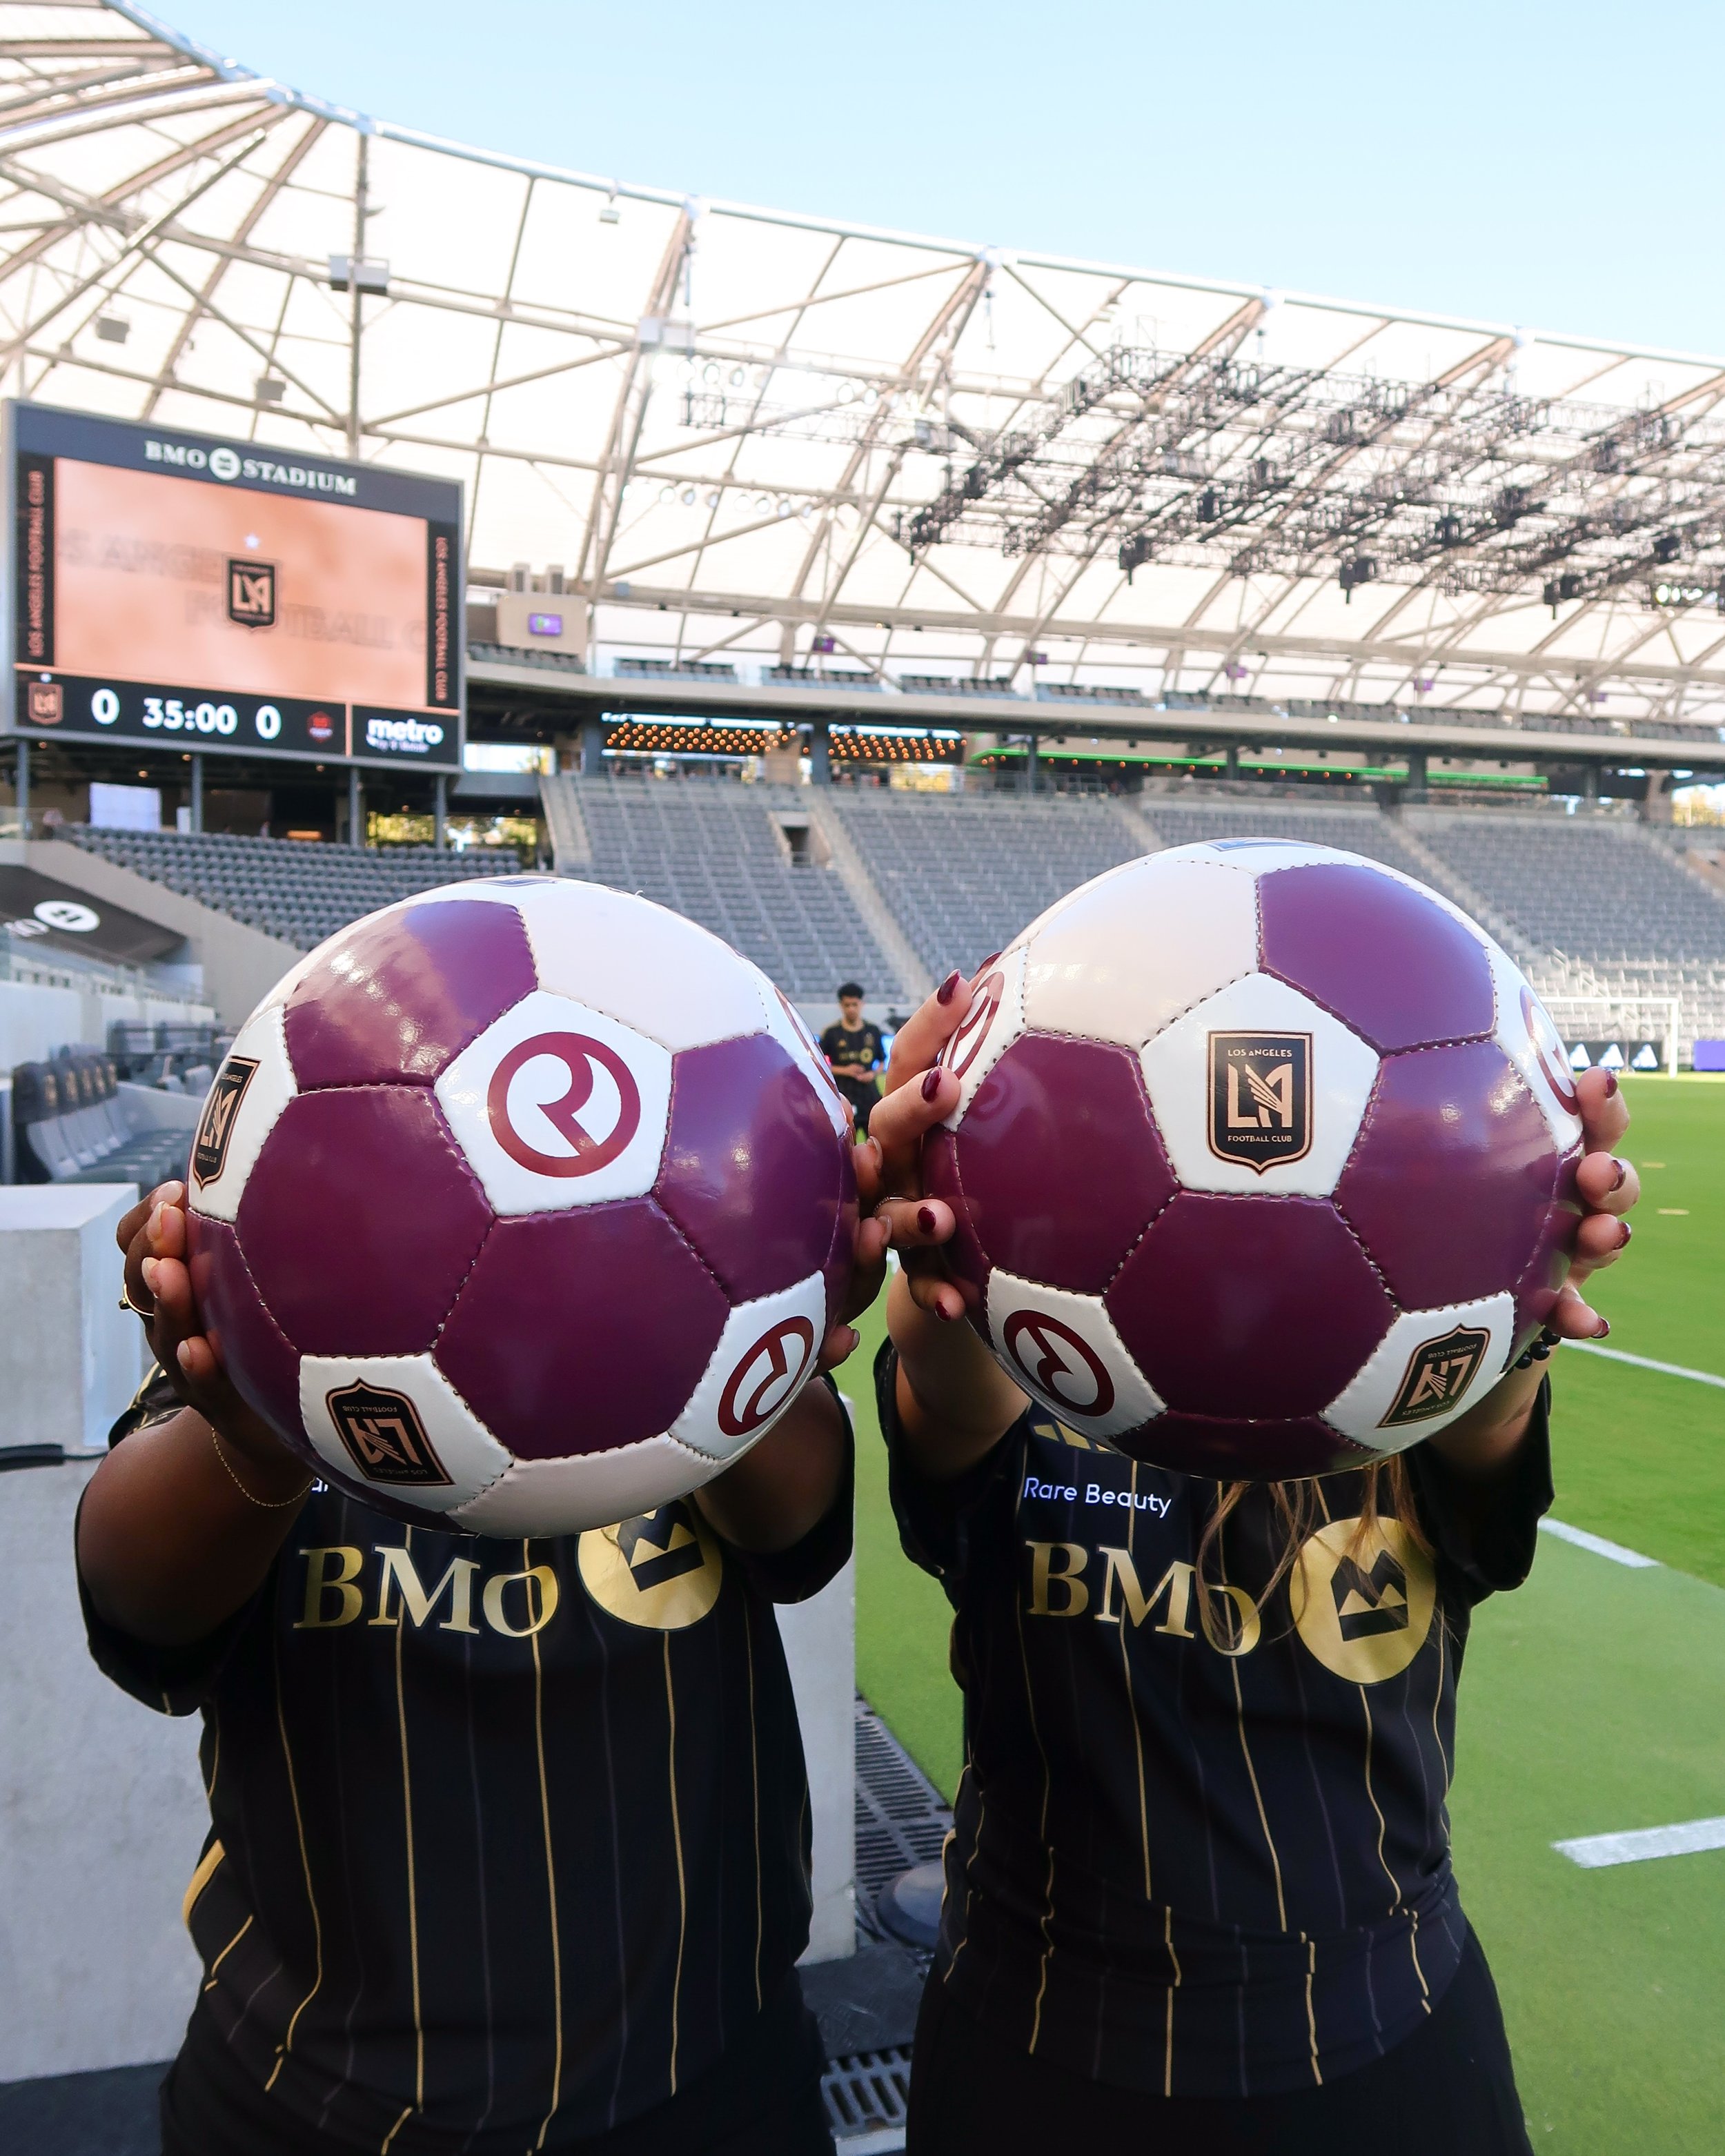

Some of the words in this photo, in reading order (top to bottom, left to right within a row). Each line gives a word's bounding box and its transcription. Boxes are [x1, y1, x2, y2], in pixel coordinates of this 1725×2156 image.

[144, 439, 207, 469] BMO
[242, 459, 357, 496] STADIUM
[91, 689, 120, 725] 0
[142, 697, 238, 735] 35:00
[255, 704, 282, 740] 0
[368, 718, 444, 745] metro
[1228, 1049, 1247, 1057] LOS
[1248, 1049, 1292, 1058] ANGELES
[1023, 1477, 1078, 1501] Rare
[1085, 1483, 1172, 1519] Beauty
[293, 1545, 560, 1638] BMO
[1025, 1540, 1261, 1656] BMO
